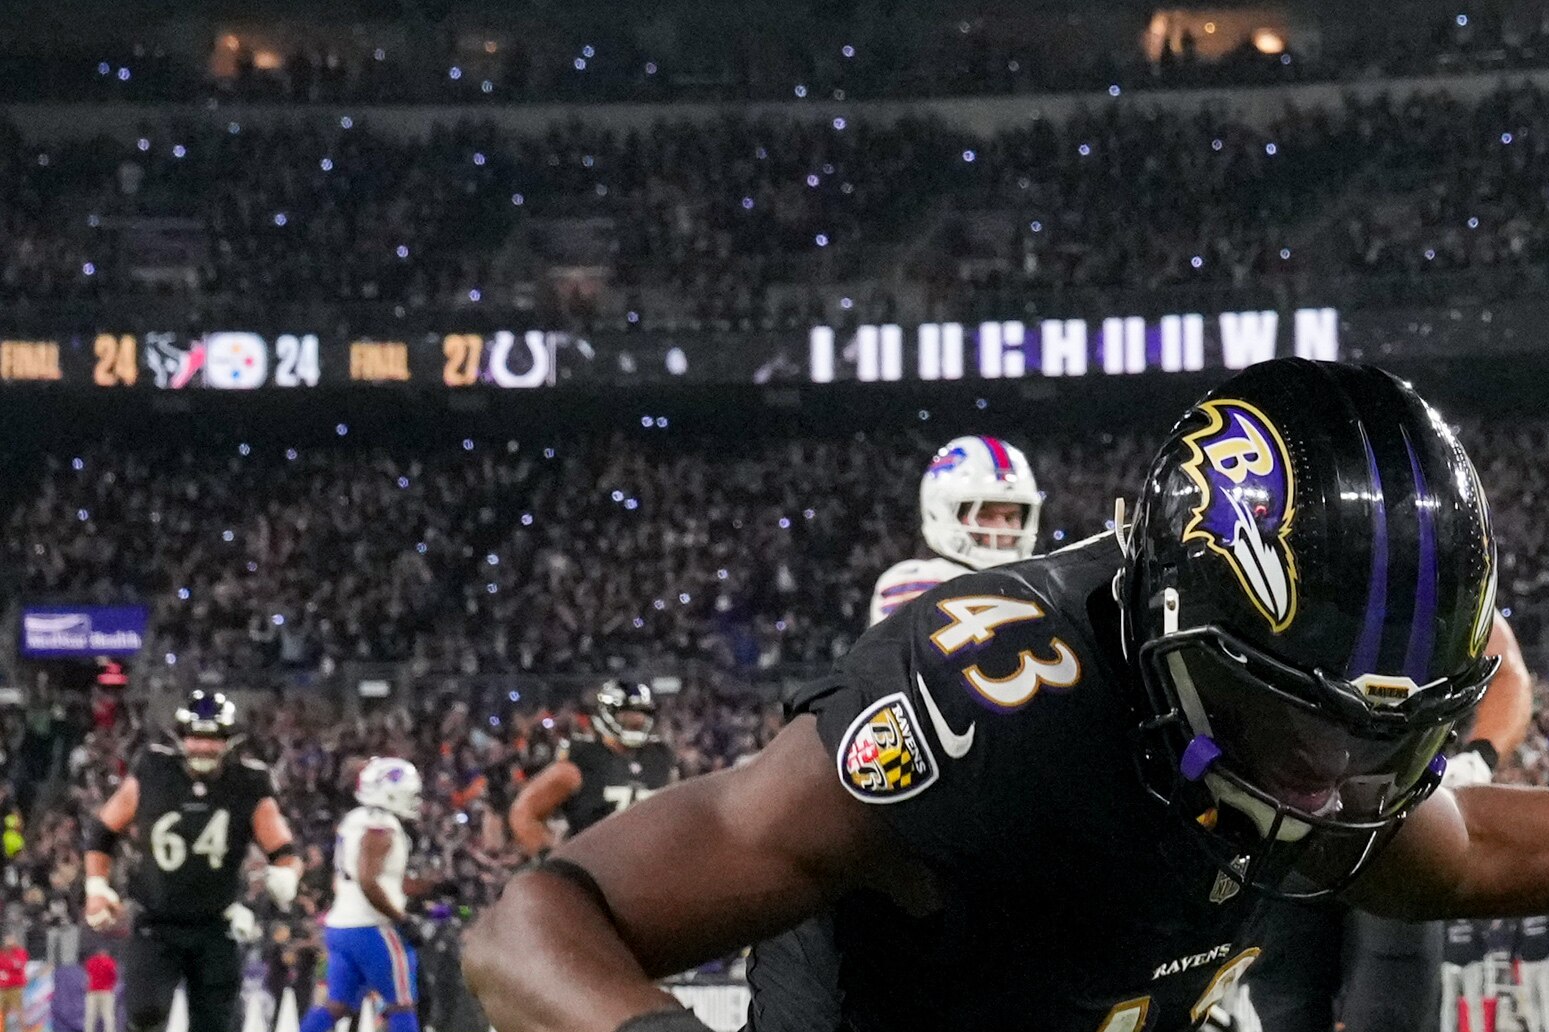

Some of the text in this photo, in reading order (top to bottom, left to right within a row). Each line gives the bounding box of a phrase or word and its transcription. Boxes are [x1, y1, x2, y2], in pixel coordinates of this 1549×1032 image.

[0, 341, 61, 380] FINAL
[94, 334, 137, 386] 24
[275, 334, 319, 387] 24
[350, 342, 410, 381] FINAL
[443, 334, 482, 386] 27
[930, 595, 1082, 708] 43
[891, 702, 926, 775] RAVENS
[150, 808, 230, 873] 64
[1151, 943, 1232, 980] RAVENS
